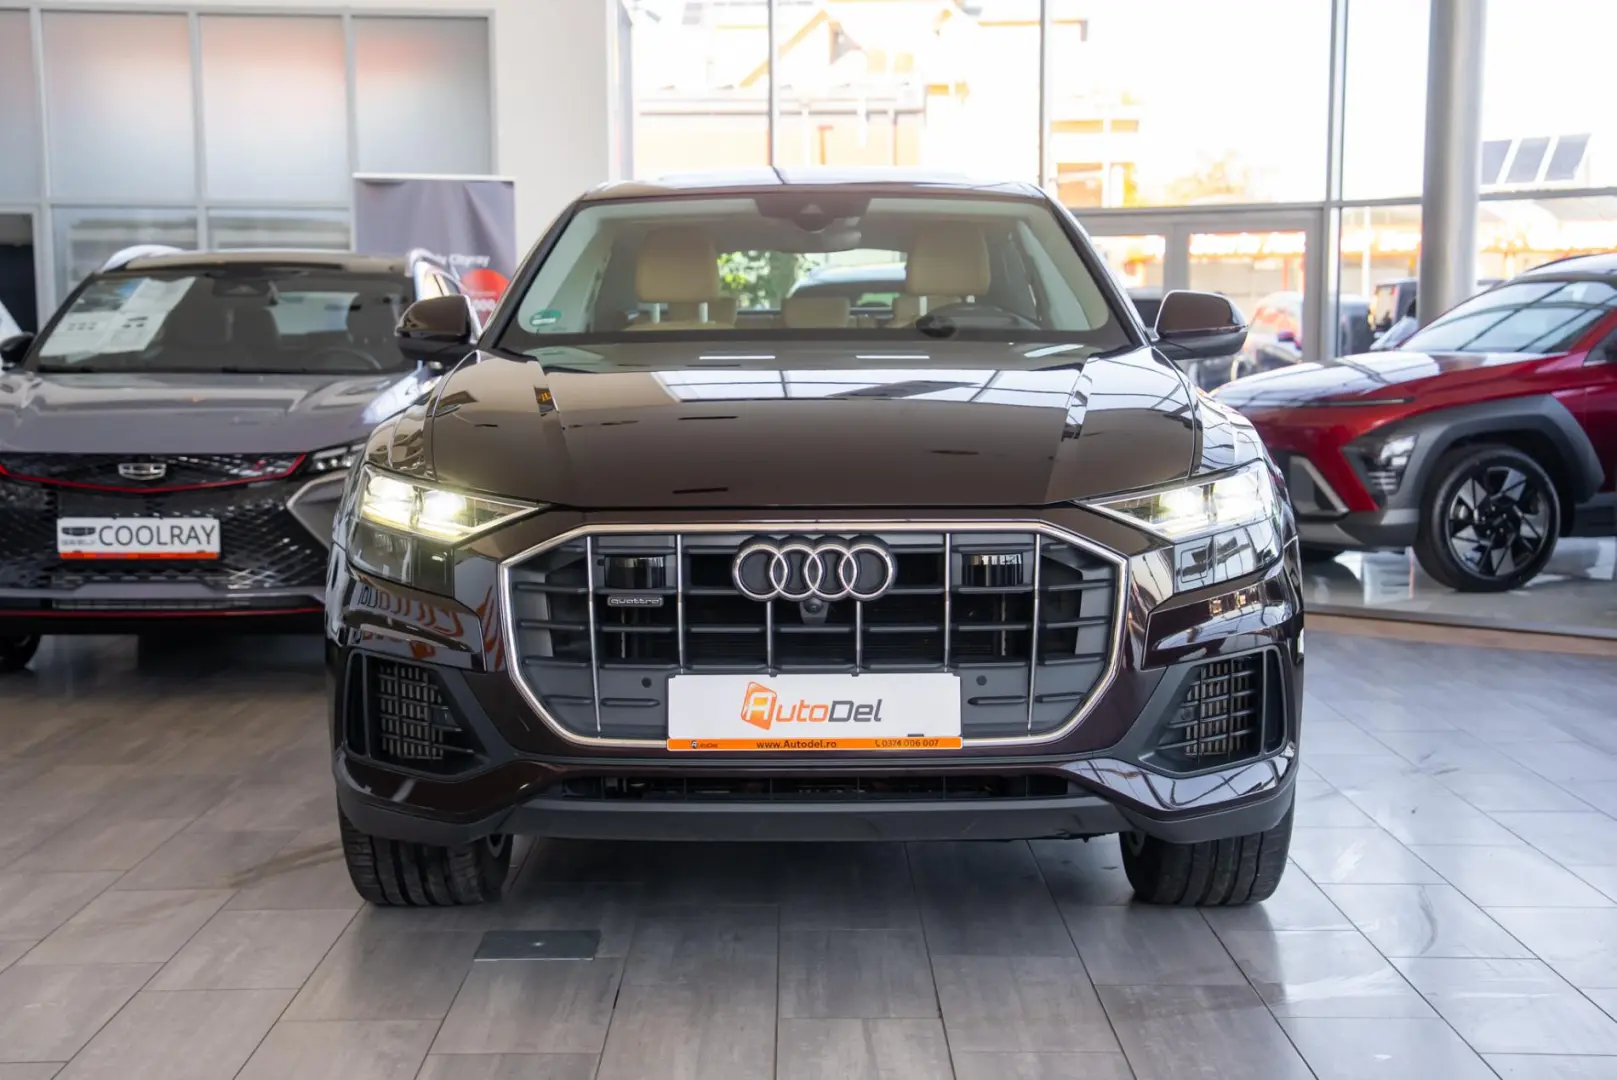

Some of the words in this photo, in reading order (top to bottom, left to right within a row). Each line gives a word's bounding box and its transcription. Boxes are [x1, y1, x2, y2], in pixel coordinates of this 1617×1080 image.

[98, 525, 215, 546] COOLRAY
[741, 683, 882, 729] AutoDel
[756, 739, 837, 749] www.Autodel.ro
[881, 739, 902, 748] 0374
[903, 739, 921, 748] 006
[922, 739, 939, 748] 007
